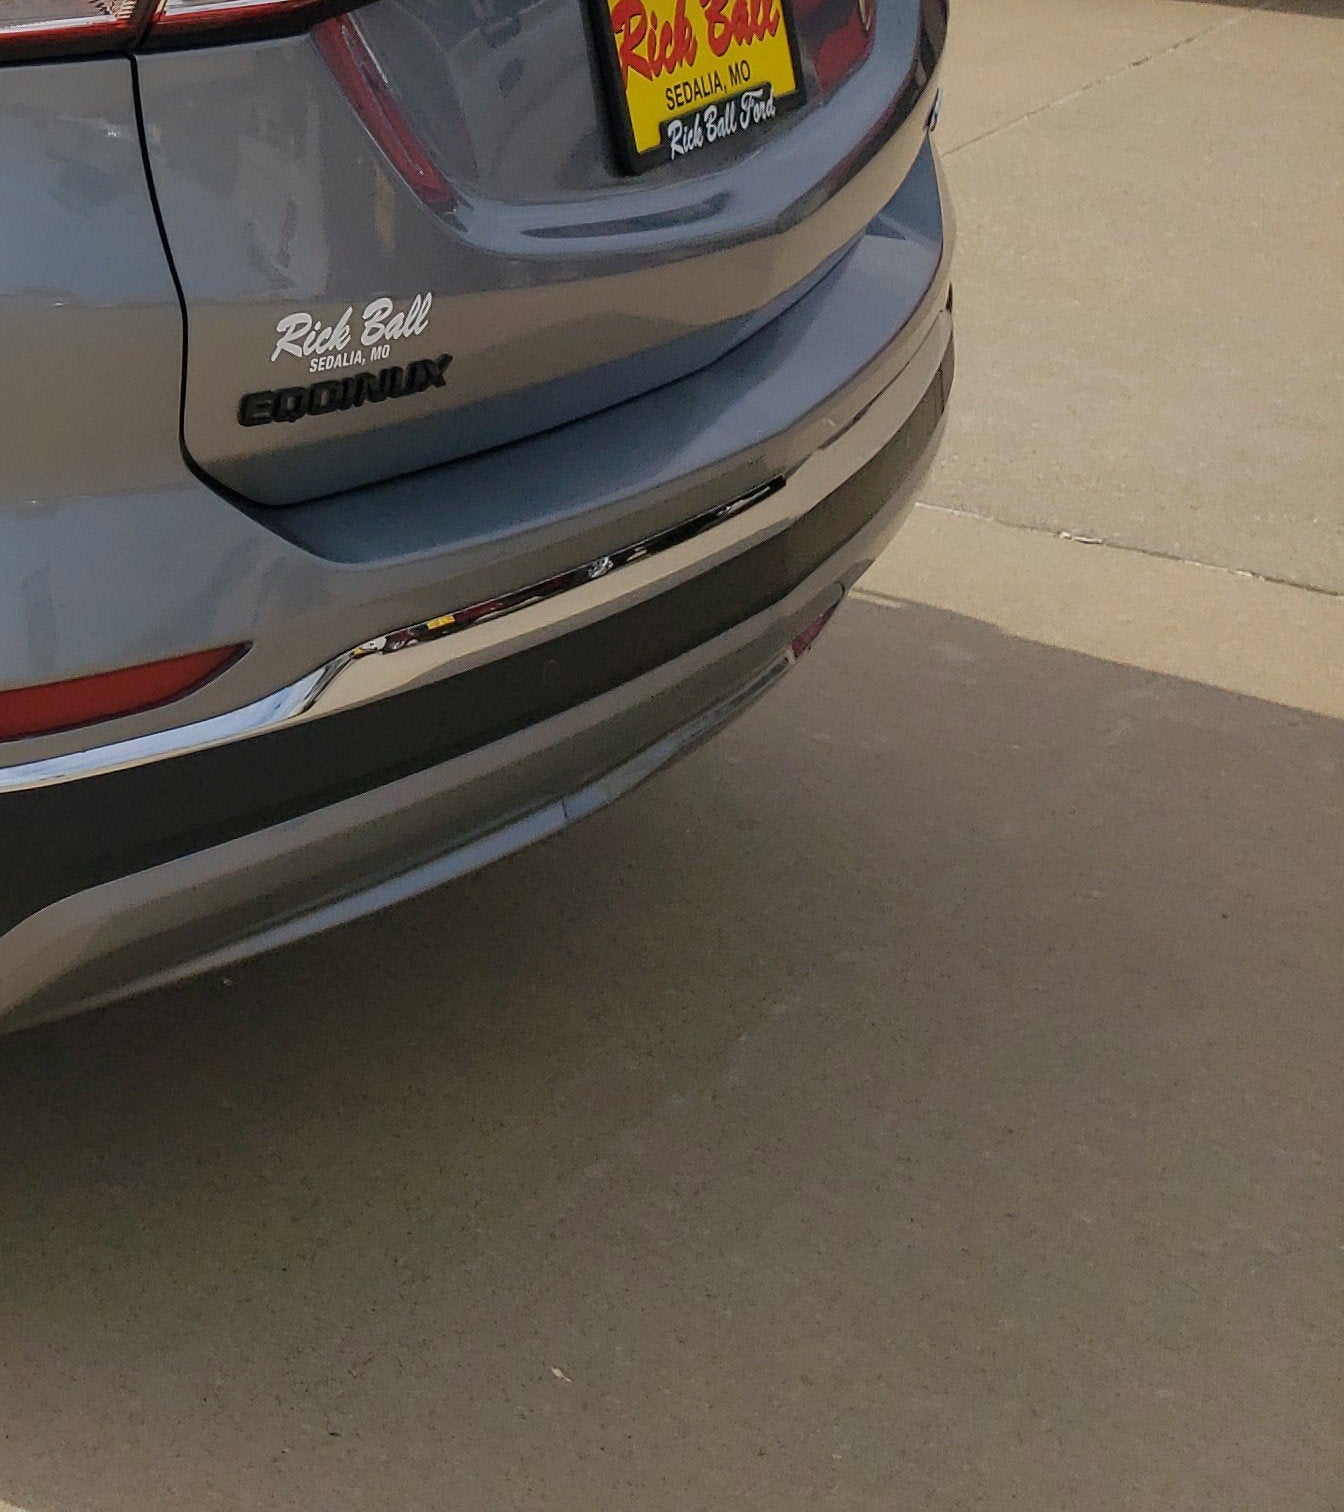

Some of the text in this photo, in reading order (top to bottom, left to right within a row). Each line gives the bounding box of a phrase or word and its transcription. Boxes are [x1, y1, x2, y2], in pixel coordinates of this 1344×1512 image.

[665, 59, 751, 111] SEDALIA, MO
[667, 86, 776, 161] Rick Ball Ford
[270, 291, 433, 363] Rick Ball
[309, 344, 391, 374] SEDALIA, MO
